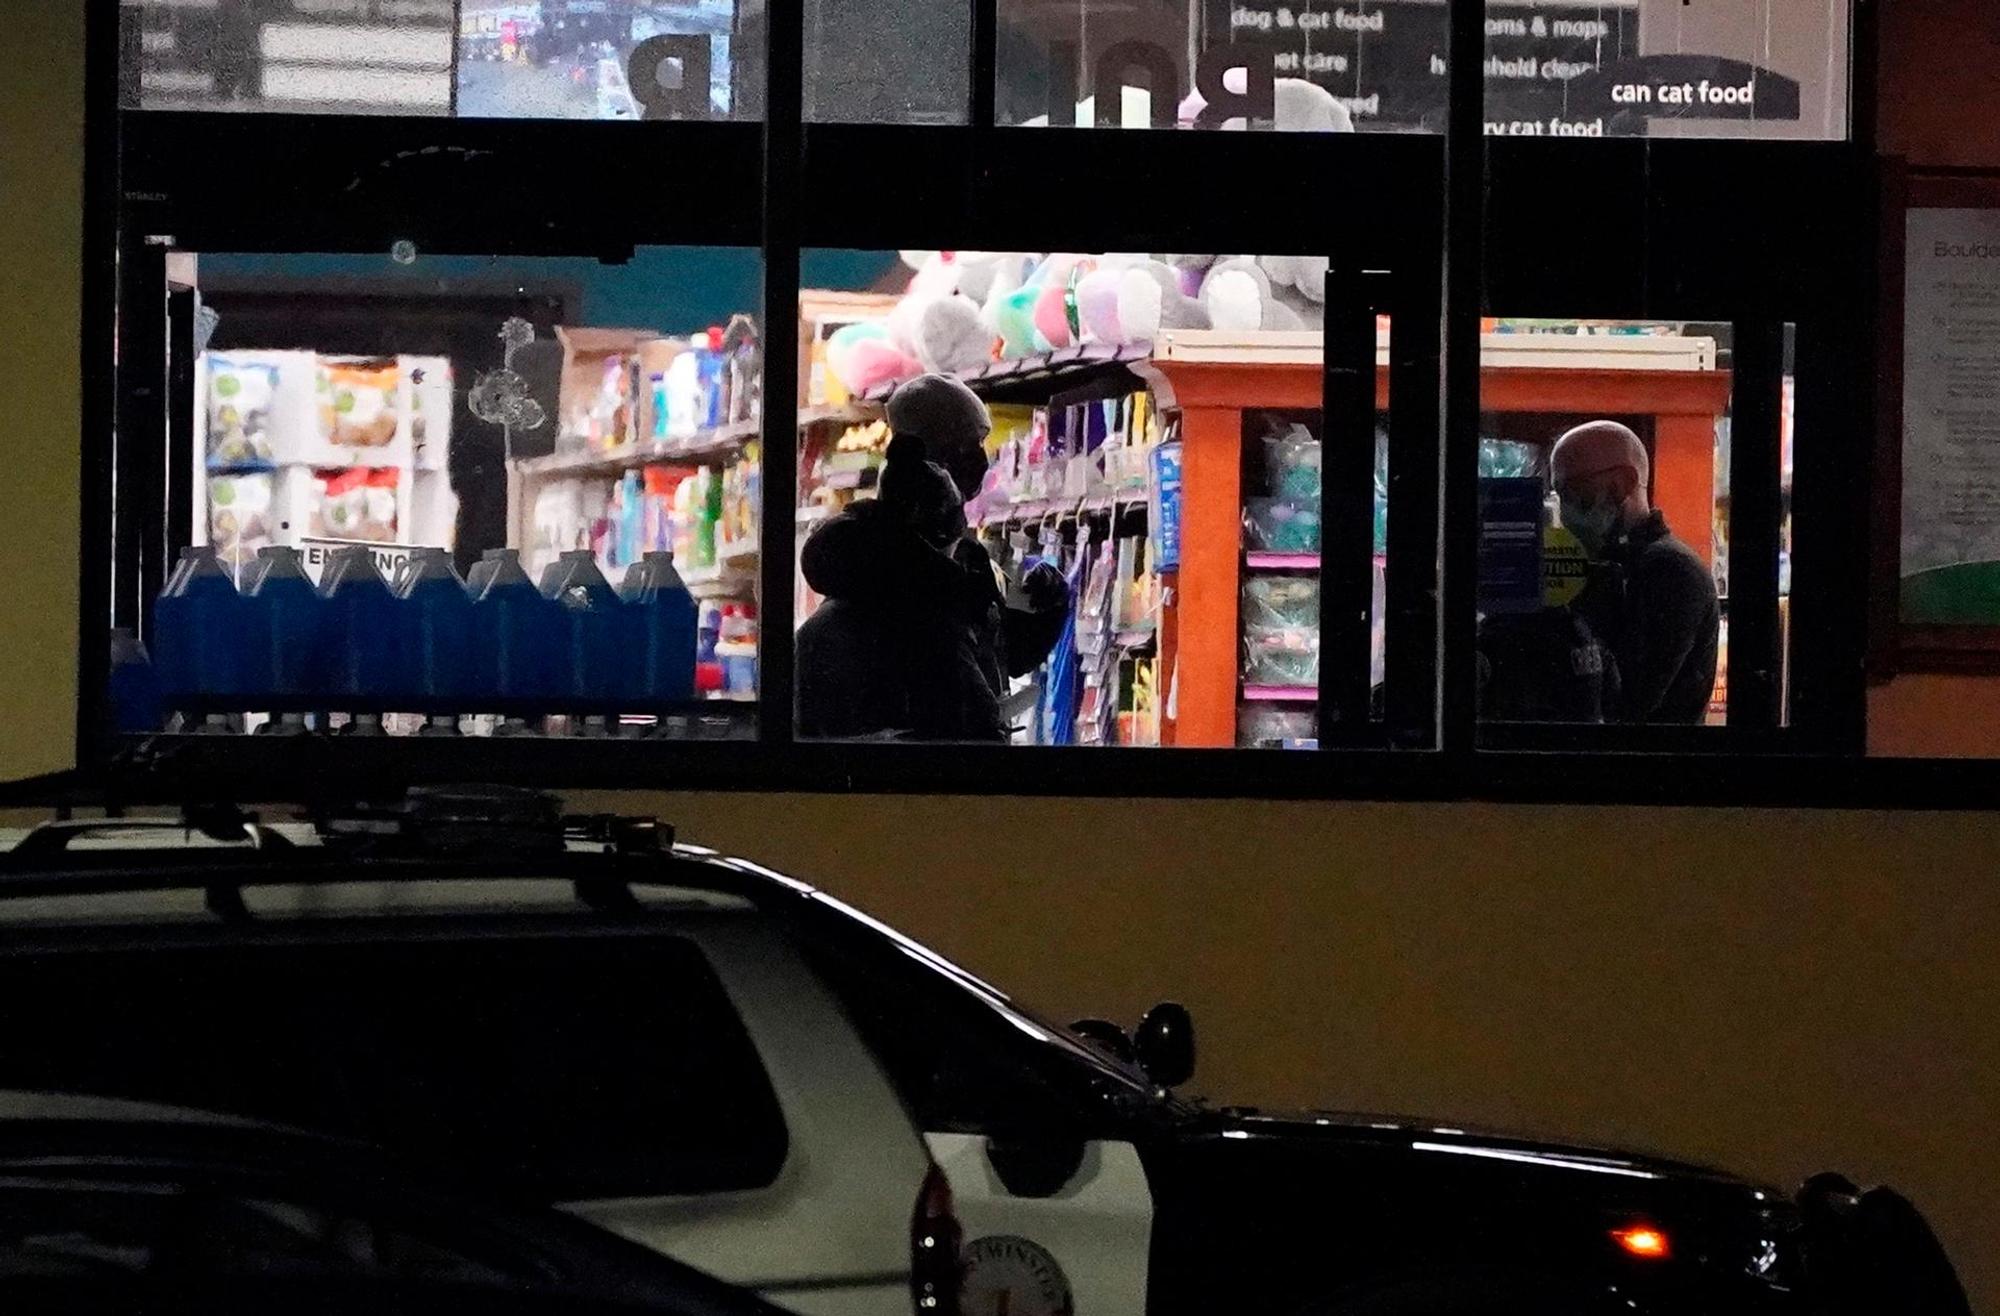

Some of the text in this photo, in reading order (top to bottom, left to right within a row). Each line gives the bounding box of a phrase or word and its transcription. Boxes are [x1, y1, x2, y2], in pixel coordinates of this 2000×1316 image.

[1231, 6, 1384, 31] dog & cat food
[1530, 16, 1547, 37] &
[1553, 20, 1609, 40] mops
[1274, 53, 1348, 72] et care
[1611, 79, 1753, 104] can cat food
[1484, 117, 1603, 137] ry cat food
